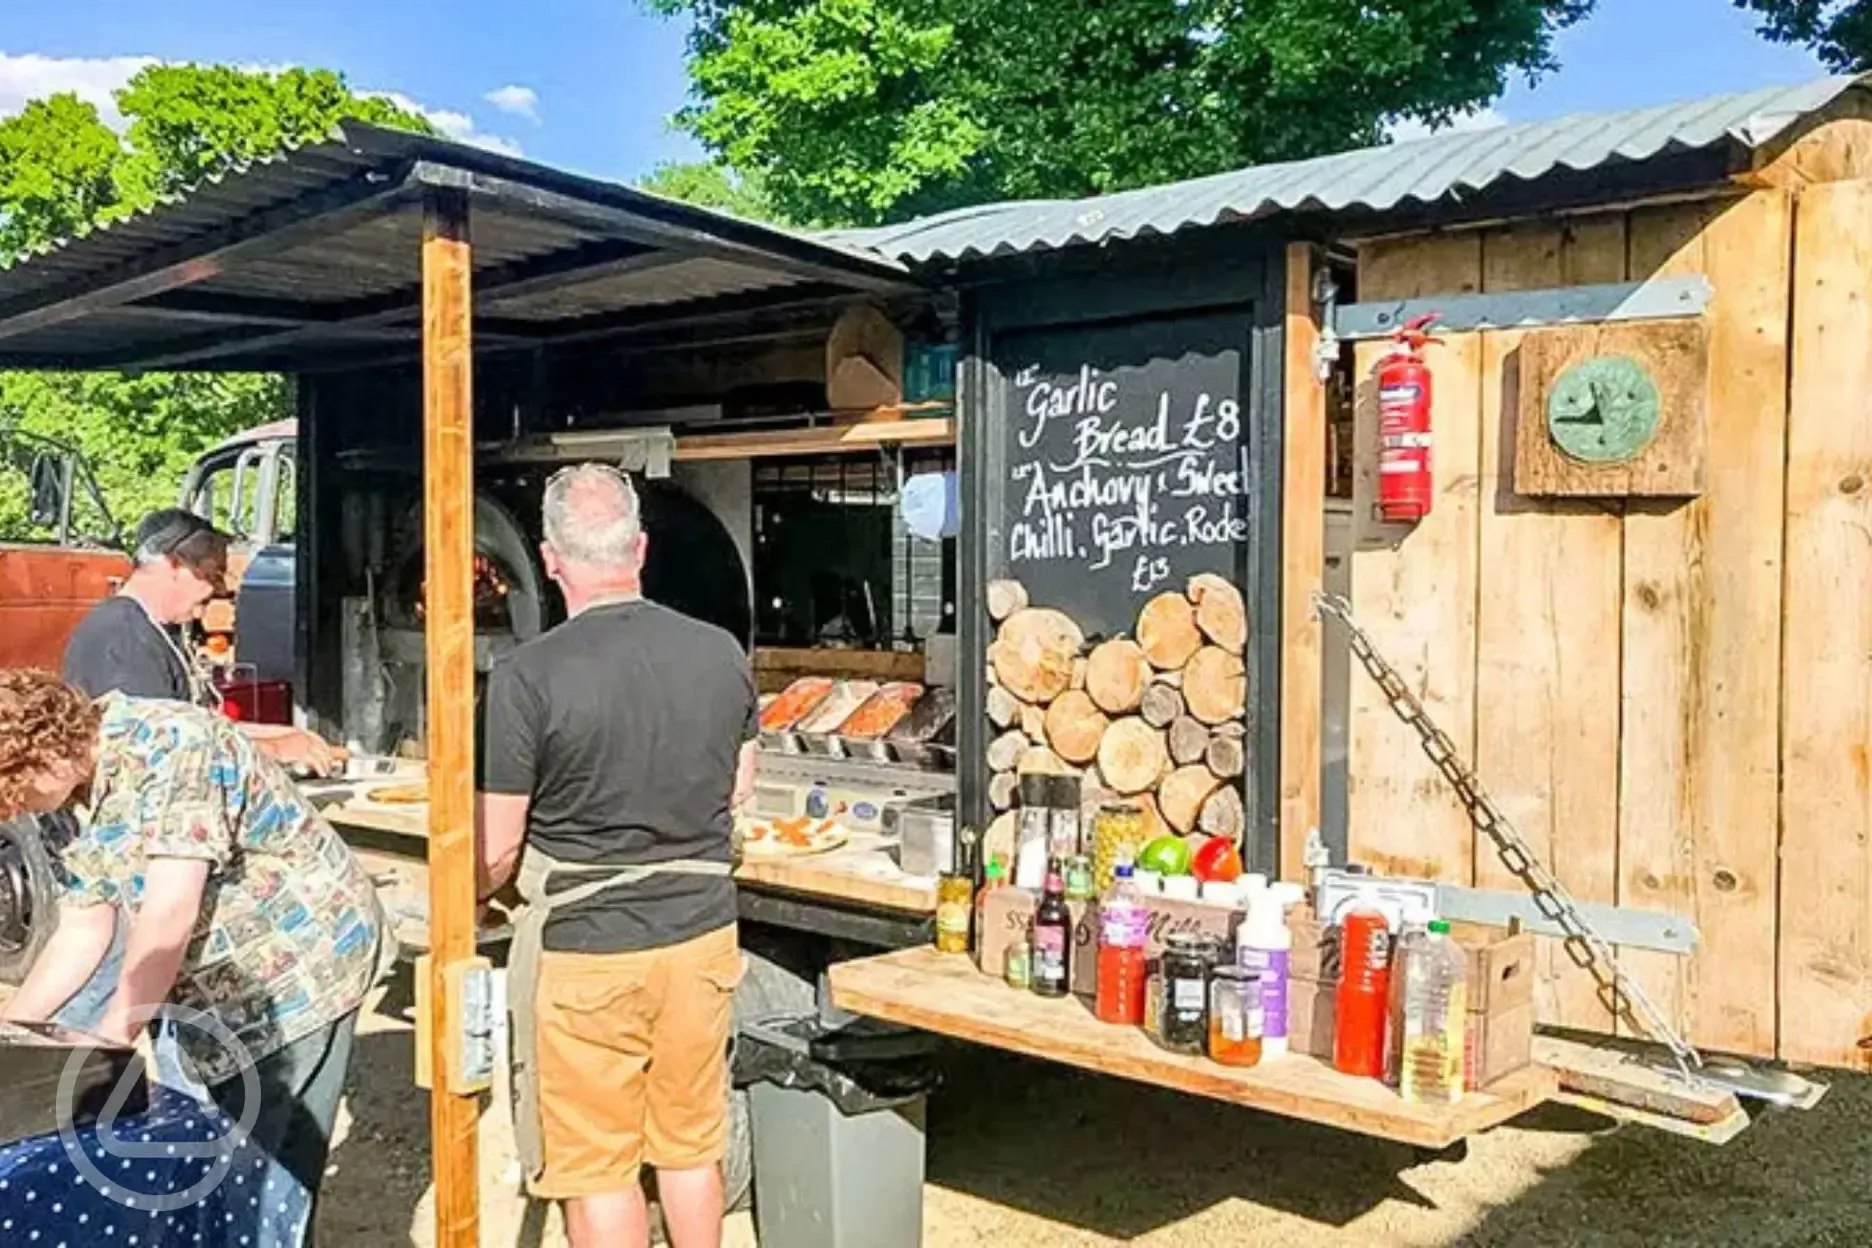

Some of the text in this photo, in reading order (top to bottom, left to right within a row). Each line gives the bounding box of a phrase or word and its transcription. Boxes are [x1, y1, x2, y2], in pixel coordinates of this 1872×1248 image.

[1019, 363, 1118, 447] Garlic
[1073, 392, 1240, 459] Bread £8
